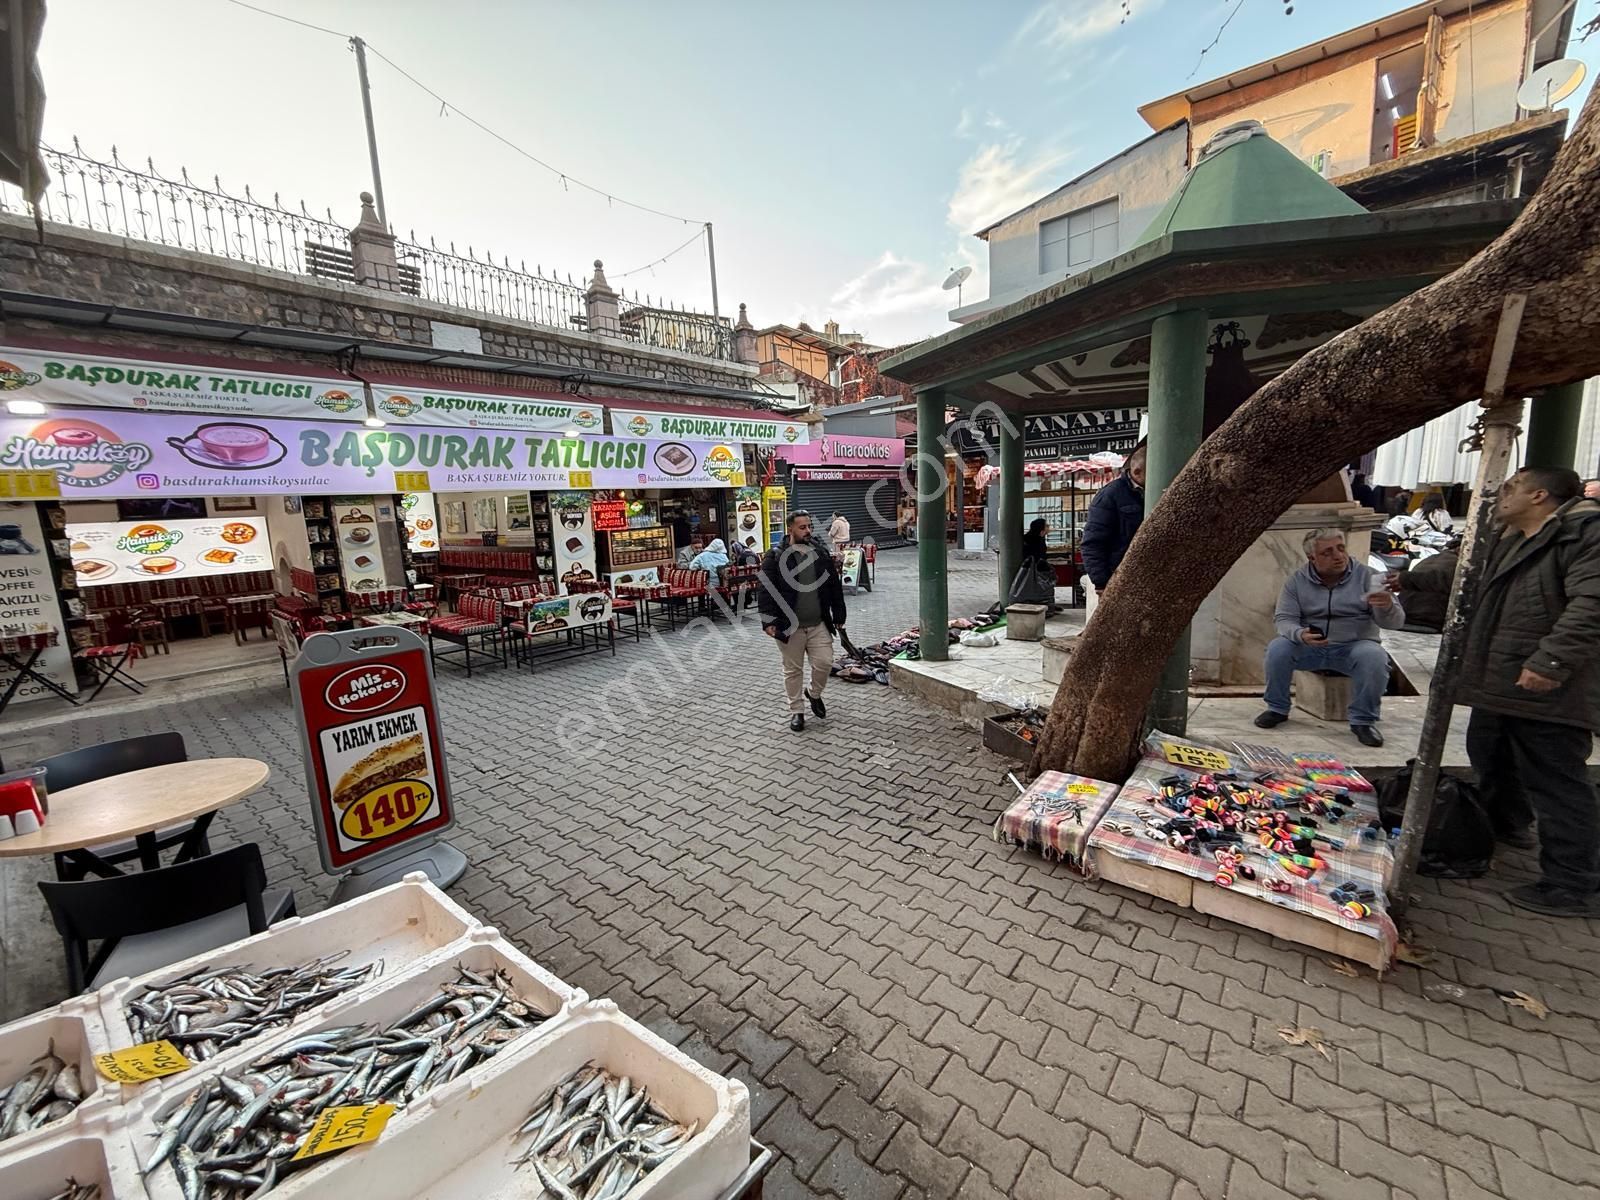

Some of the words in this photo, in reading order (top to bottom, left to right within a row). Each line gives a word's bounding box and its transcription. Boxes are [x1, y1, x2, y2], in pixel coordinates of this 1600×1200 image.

[44, 362, 200, 391] BAŞDURAK
[208, 376, 312, 399] TATLICISI
[423, 396, 507, 414] BAŞDURAK
[512, 403, 571, 418] TATLICISI
[661, 418, 726, 438] BAŞDURAK
[730, 422, 776, 438] TATLICISI
[299, 429, 515, 477] BAŞDURAK
[524, 438, 646, 469] TATLICISI
[833, 441, 890, 458] linarookids
[1024, 446, 1057, 457] PANAYIR
[57, 469, 120, 486] SÜTLACI
[163, 475, 330, 489] basdurakhamsikoysutlac
[447, 474, 481, 484] BAŞKA
[483, 472, 528, 483] ŞUBEMİZ
[810, 471, 843, 480] linarookids
[0, 608, 40, 618] OFFEE
[338, 678, 400, 705] Kokoreç
[350, 673, 382, 692] Mis
[332, 723, 375, 753] YARIM
[376, 713, 418, 740] EKMEK
[1170, 752, 1204, 765] 15
[1172, 746, 1218, 758] TOKA
[353, 786, 416, 836] 140
[329, 1118, 368, 1143] 150
